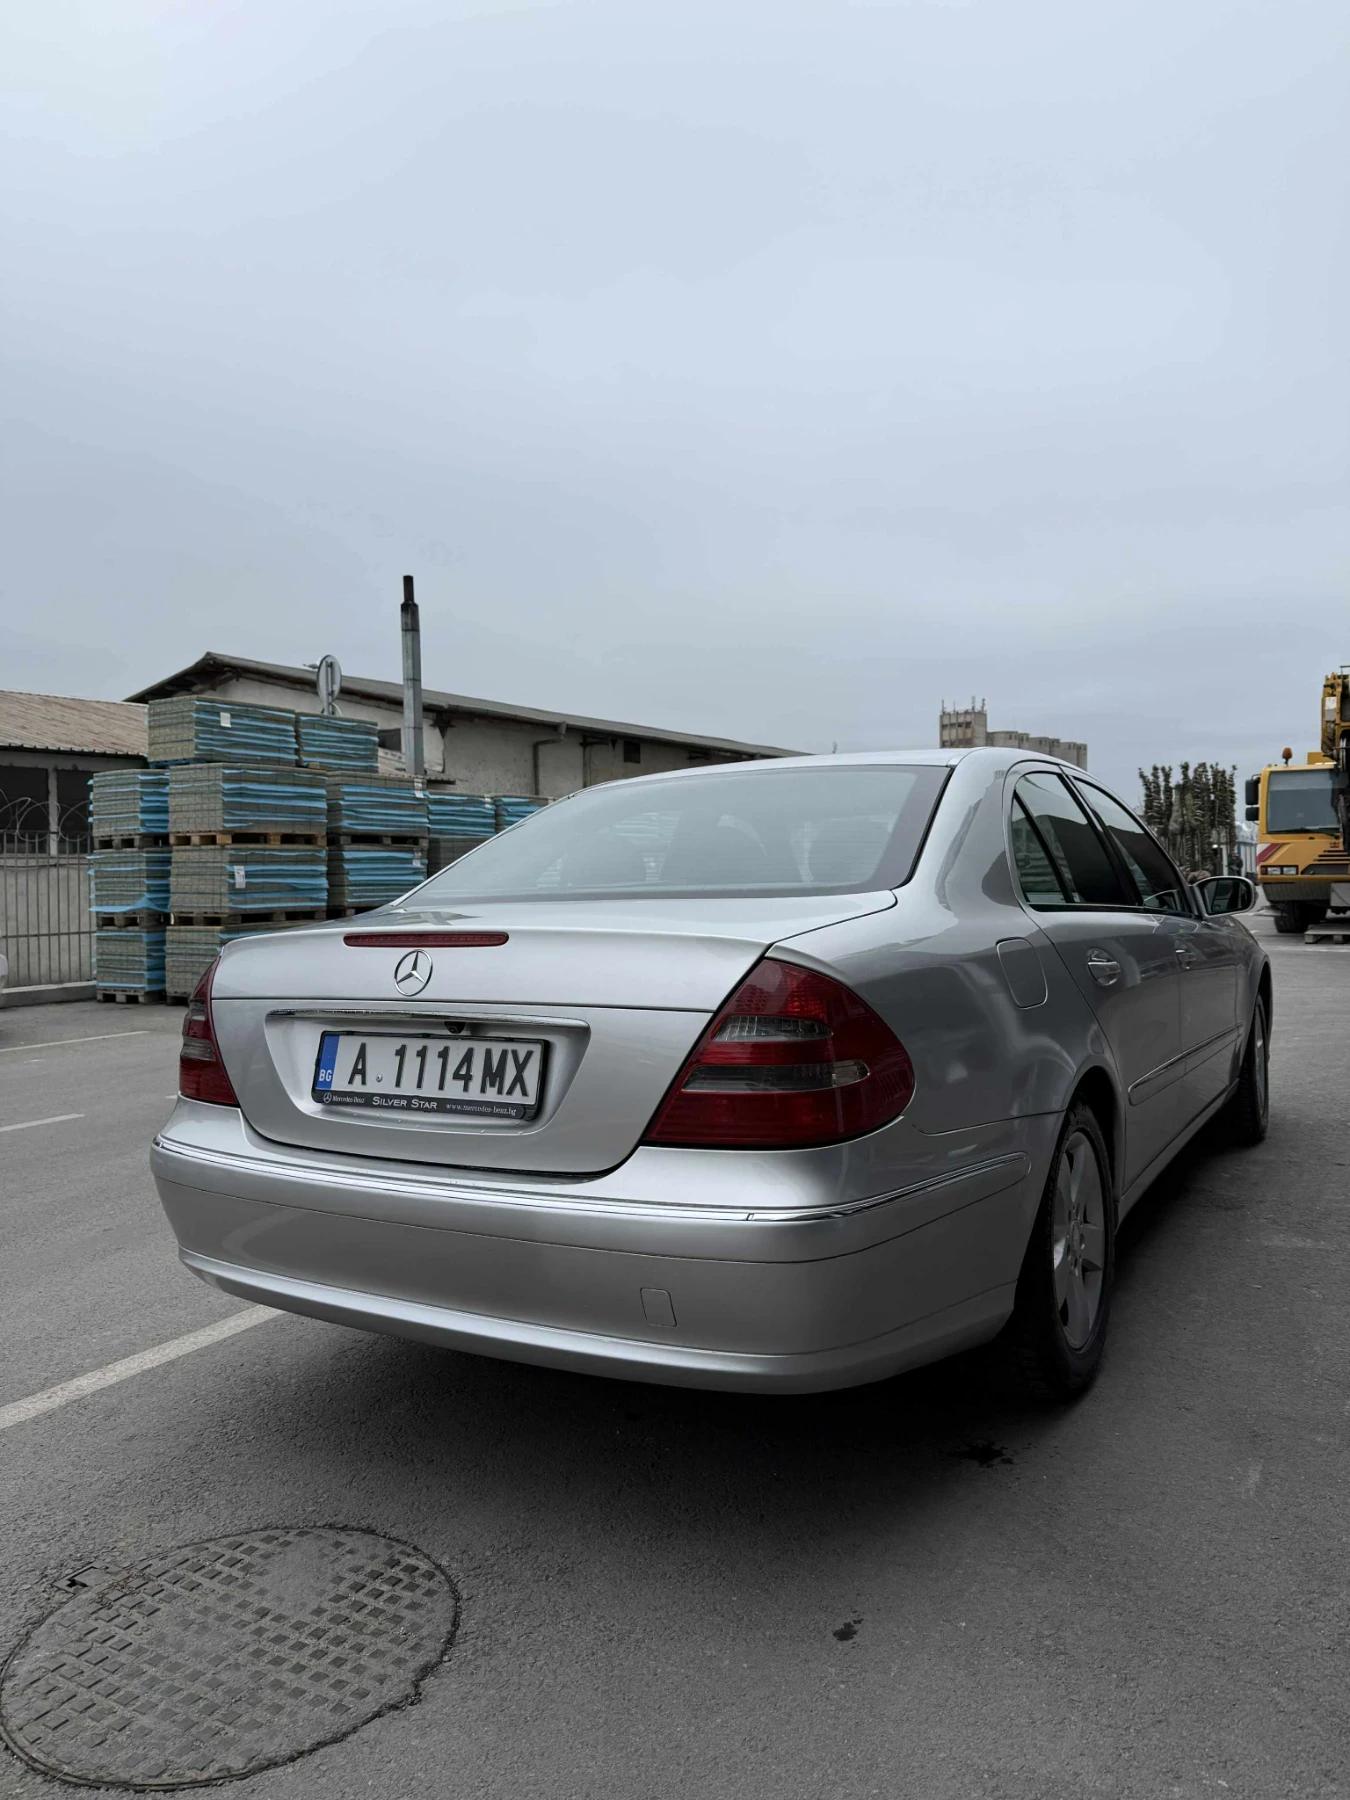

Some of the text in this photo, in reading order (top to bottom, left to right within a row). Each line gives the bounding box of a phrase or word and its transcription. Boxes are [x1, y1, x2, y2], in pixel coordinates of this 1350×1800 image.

[348, 1042, 367, 1086] A
[318, 1069, 333, 1082] BG
[372, 1096, 408, 1107] SILVER
[411, 1098, 438, 1109] STAR
[446, 1103, 517, 1116] www.mercedes-benz.bg
